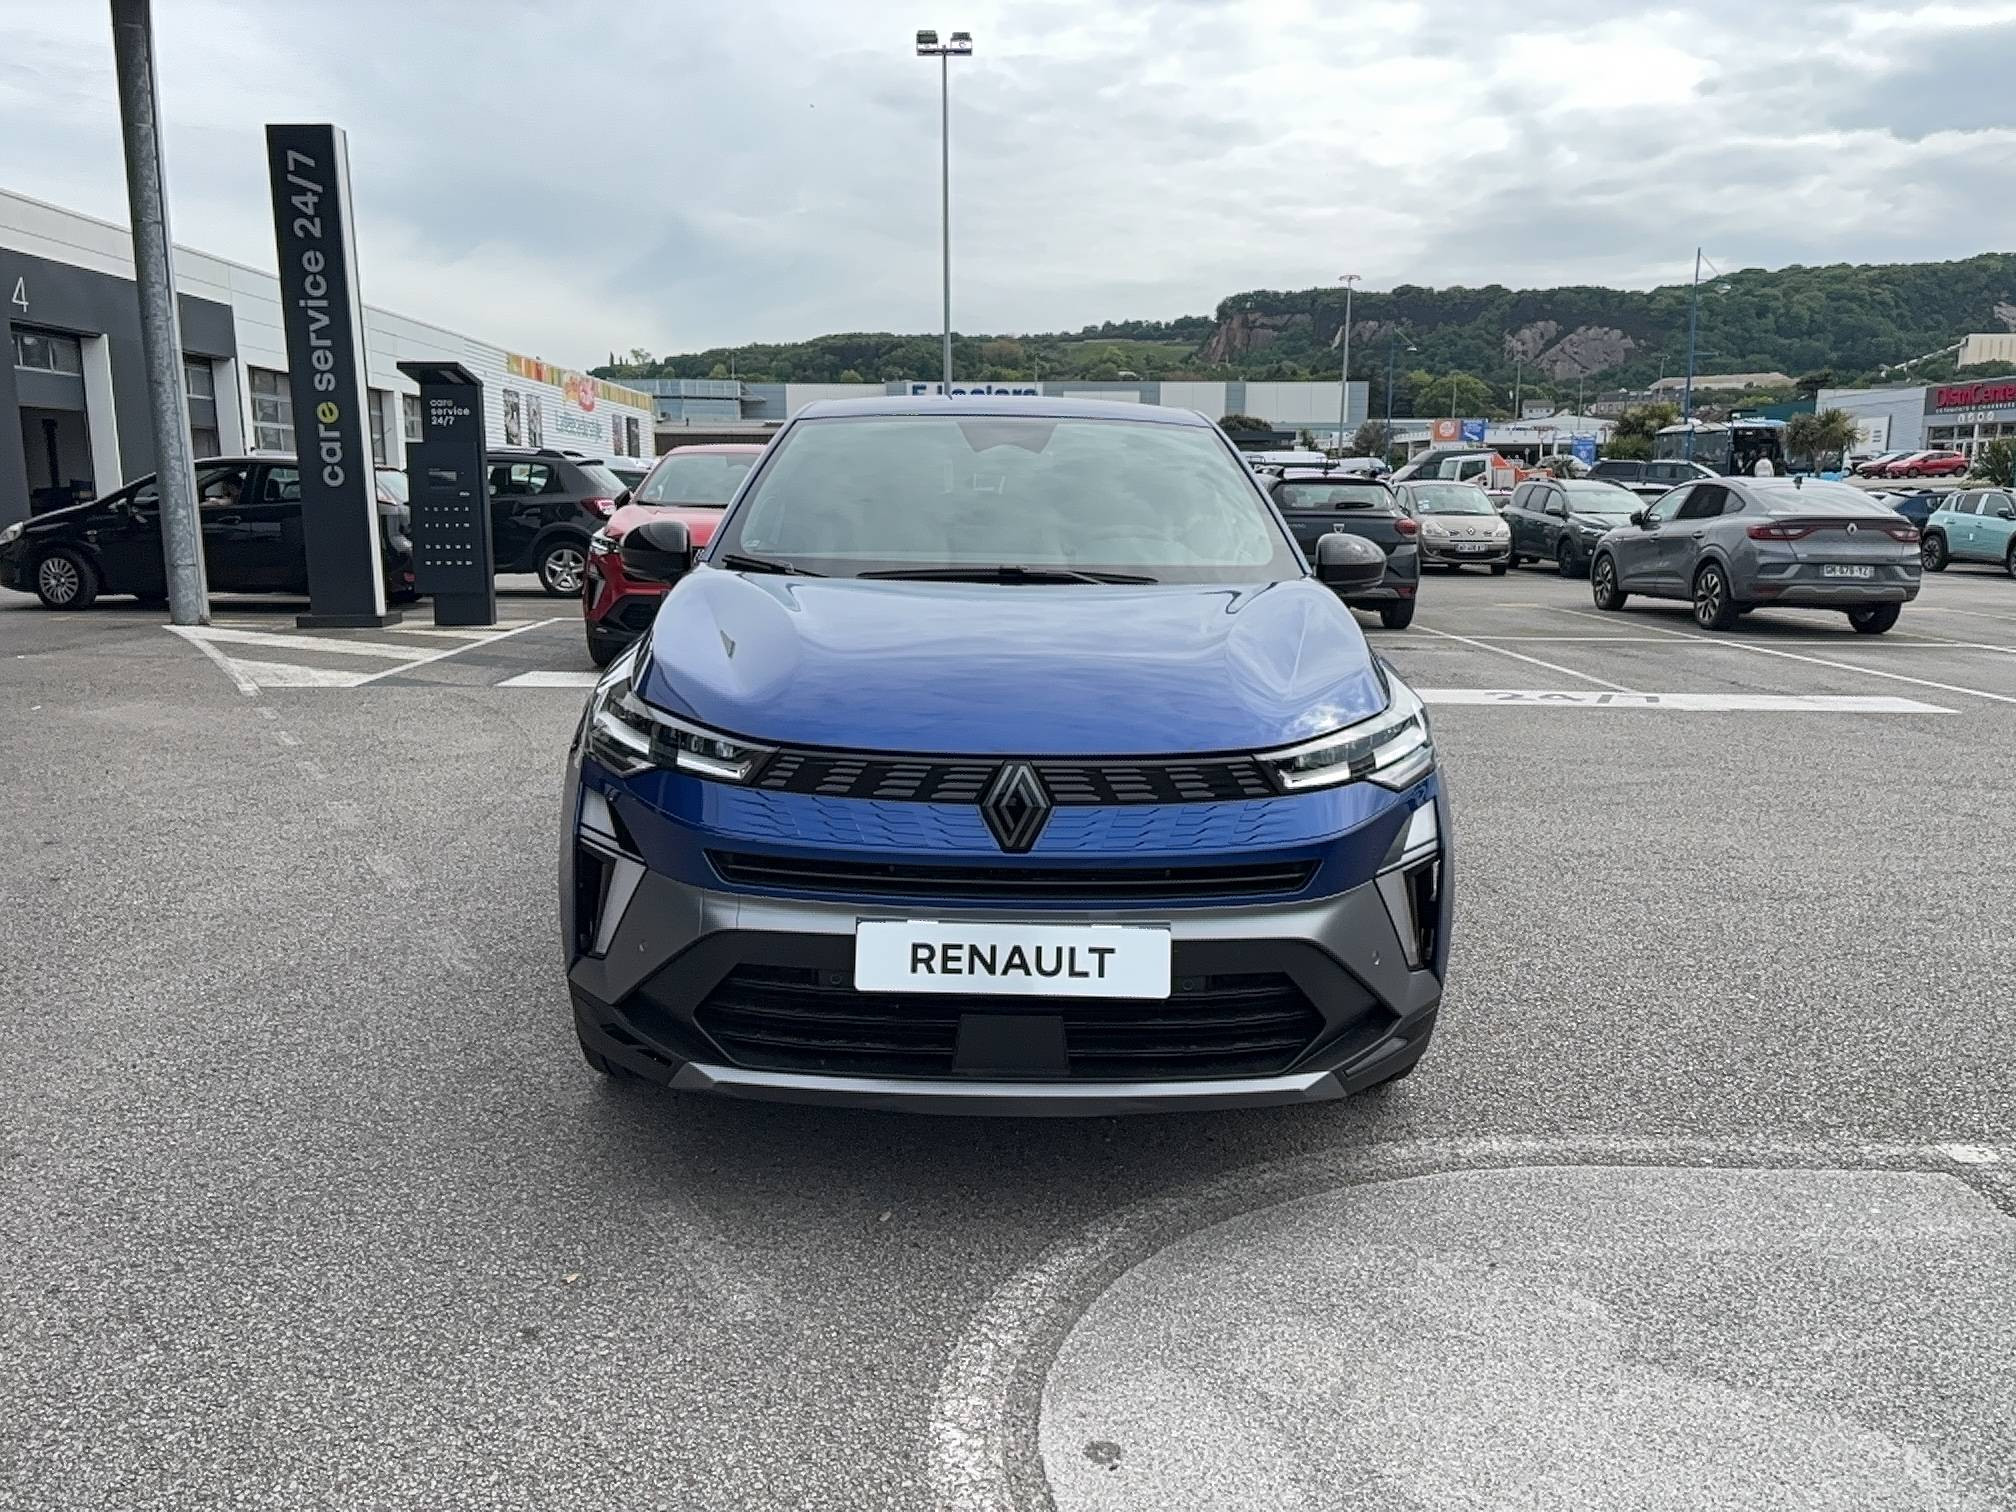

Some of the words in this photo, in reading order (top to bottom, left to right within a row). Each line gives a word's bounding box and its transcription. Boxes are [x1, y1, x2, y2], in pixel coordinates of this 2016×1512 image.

[286, 149, 324, 239] 24/7
[12, 276, 29, 312] 4
[299, 249, 336, 393] service
[429, 399, 454, 407] care
[430, 406, 471, 416] service
[431, 415, 455, 427] 24/7
[316, 401, 345, 488] care
[910, 942, 1116, 978] RENAULT
